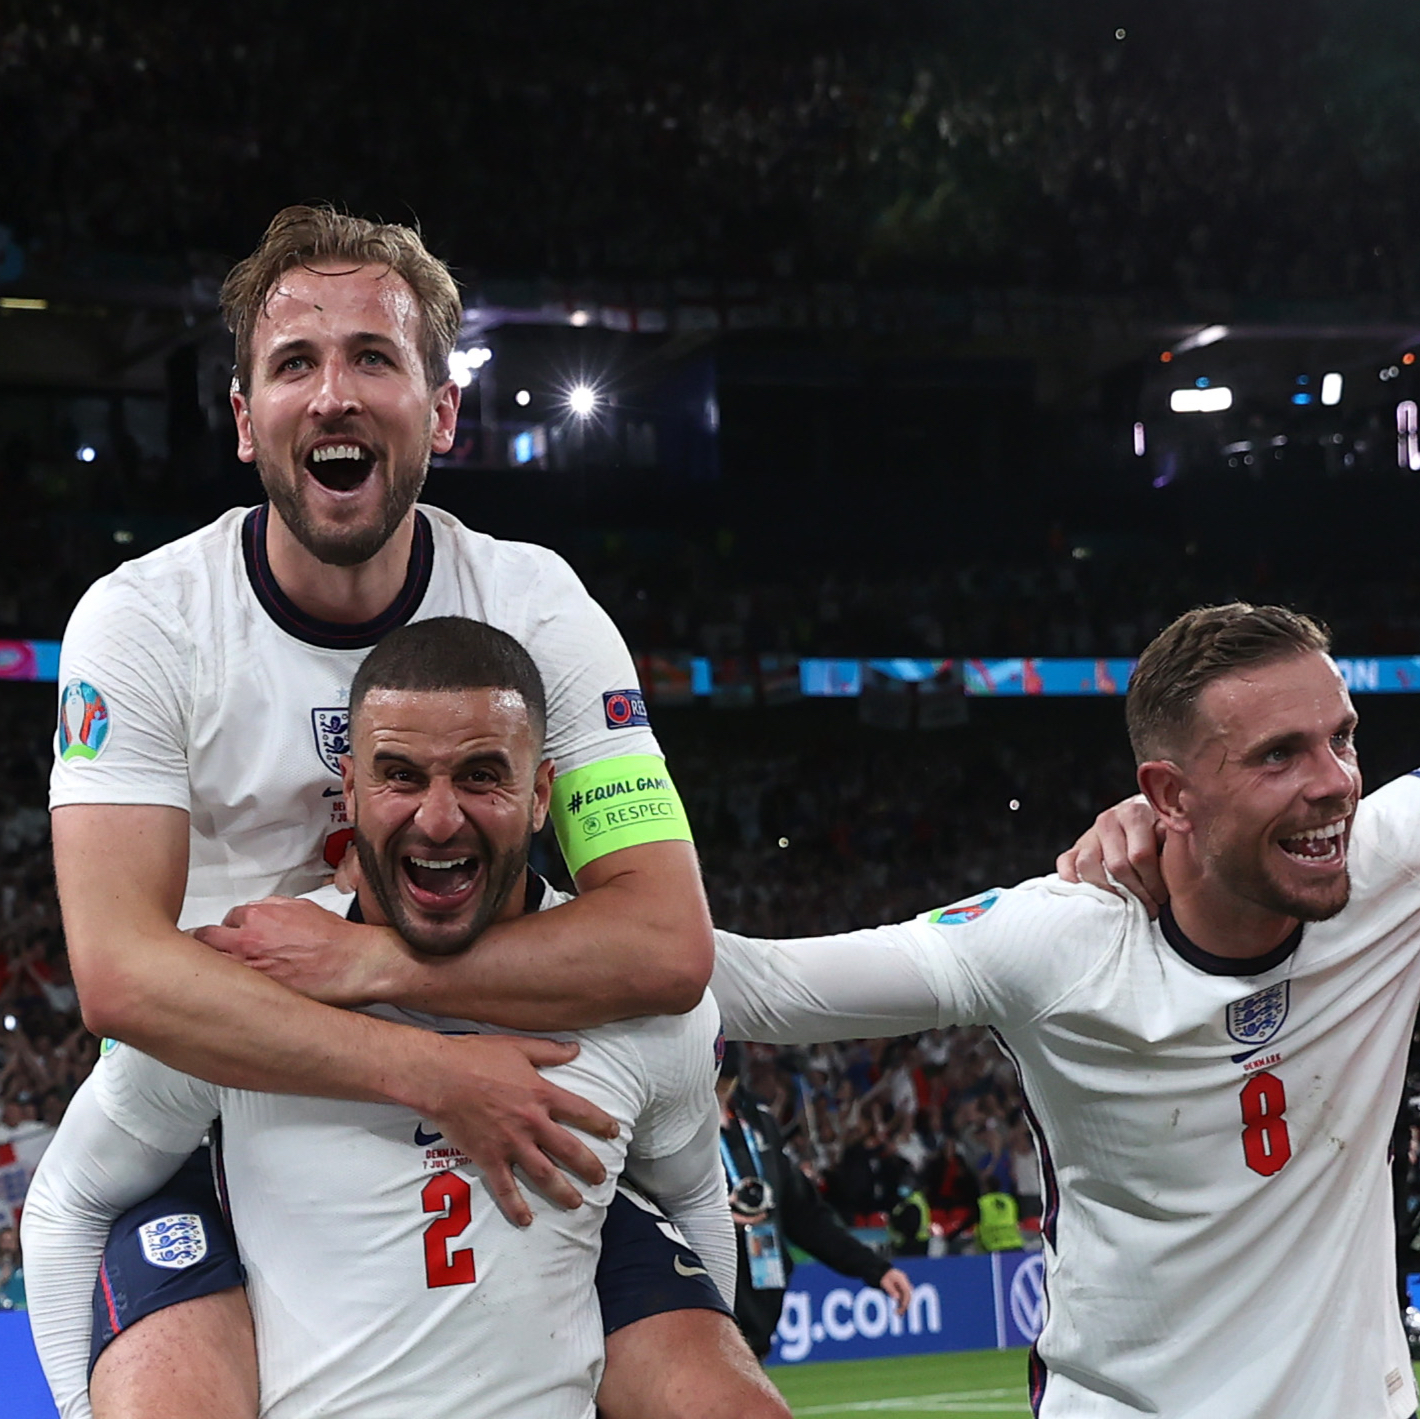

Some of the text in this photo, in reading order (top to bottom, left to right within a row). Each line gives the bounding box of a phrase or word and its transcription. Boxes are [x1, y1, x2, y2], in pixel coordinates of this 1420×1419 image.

[606, 802, 675, 826] RESPECT
[1243, 1053, 1282, 1072] DENMARK
[1239, 1071, 1293, 1178] 8
[430, 1159, 451, 1169] JULY
[421, 1170, 477, 1289] 2
